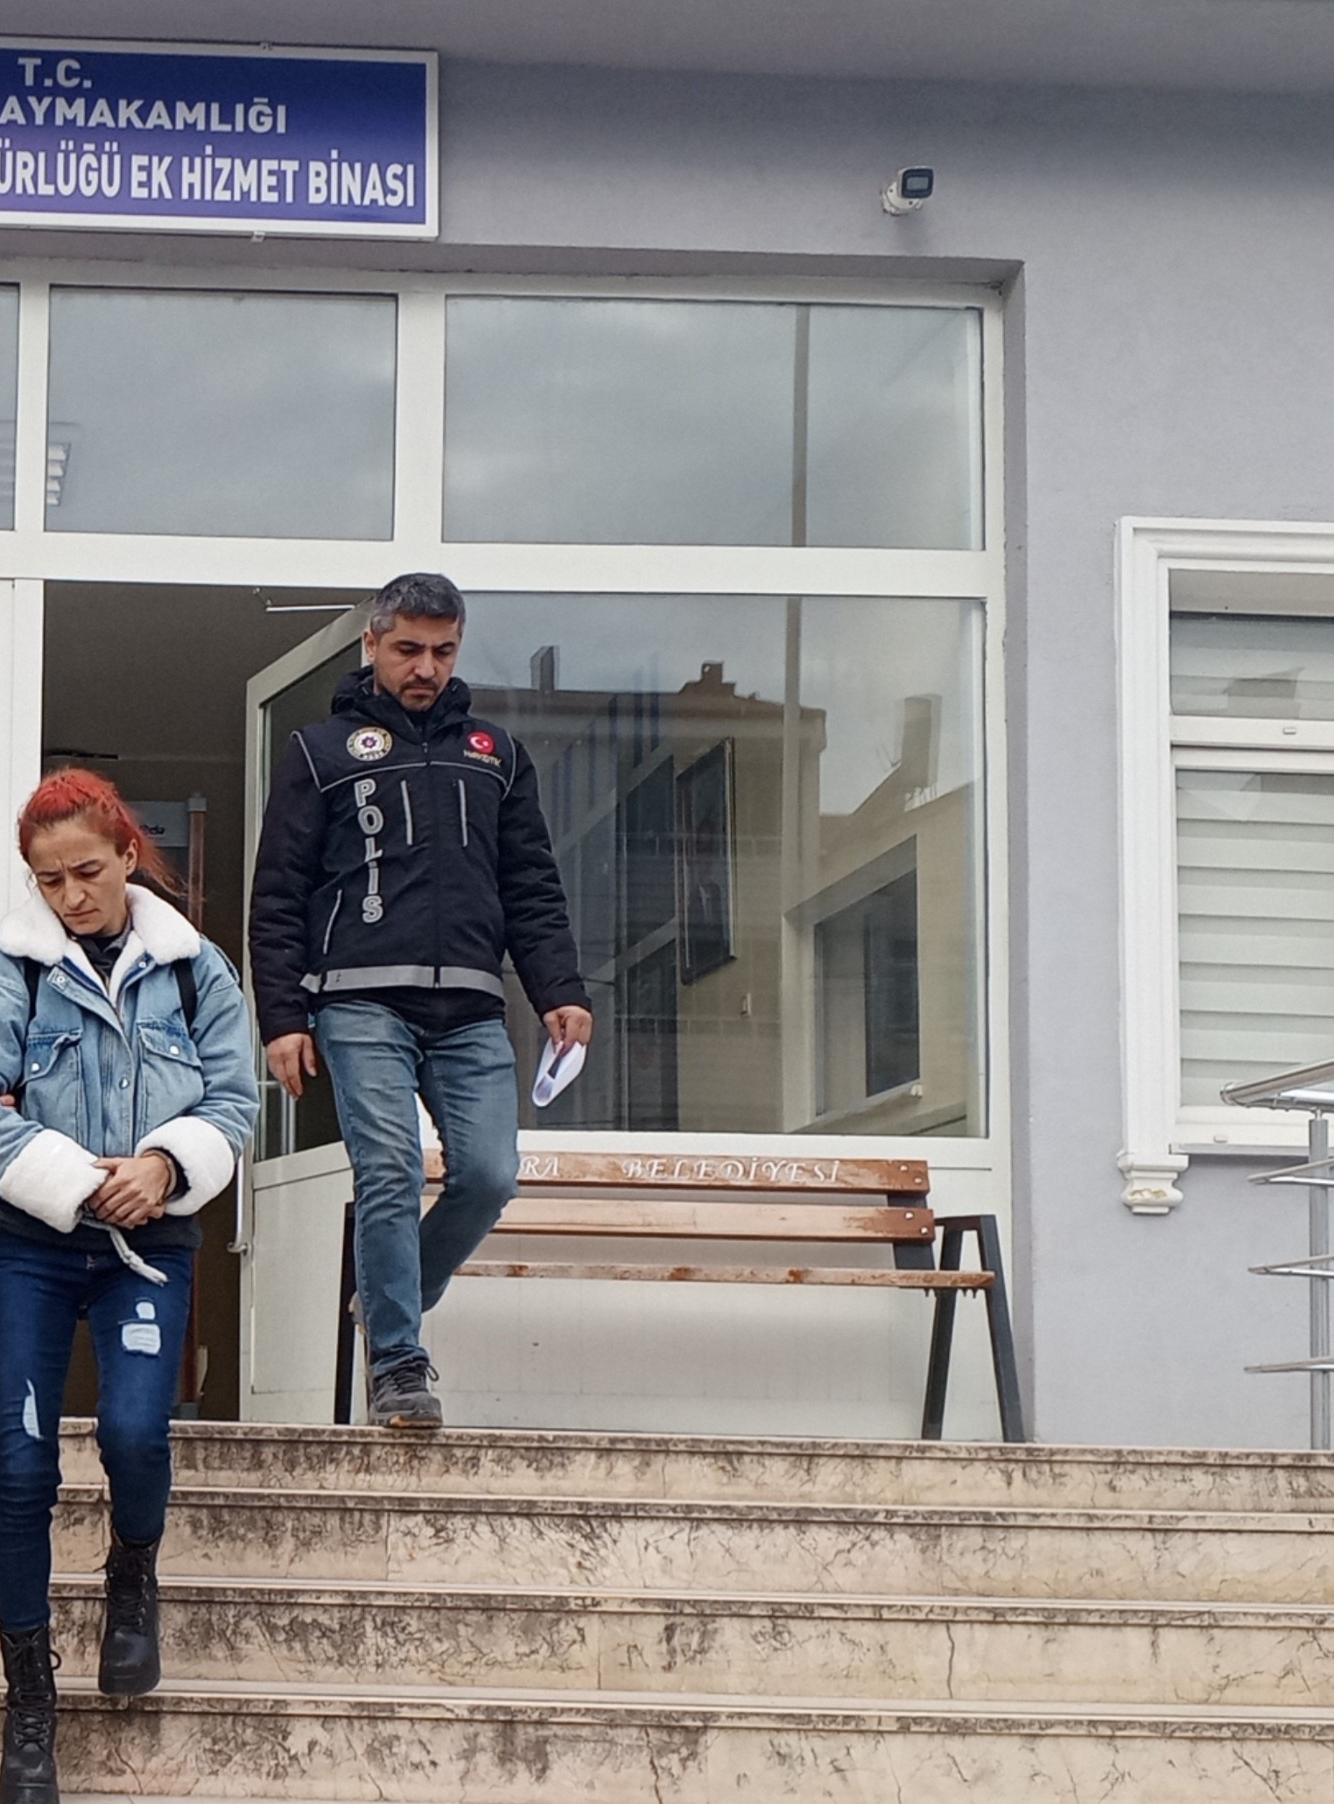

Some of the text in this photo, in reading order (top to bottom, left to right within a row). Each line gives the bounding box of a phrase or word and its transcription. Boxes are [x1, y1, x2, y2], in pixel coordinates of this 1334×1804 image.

[17, 57, 92, 88] T.C.
[131, 154, 173, 199] EK
[181, 145, 299, 203] HİZMET
[308, 149, 415, 207] BİNASI
[353, 778, 384, 924] POLİS
[622, 1156, 841, 1183] BELEDİYESİ
